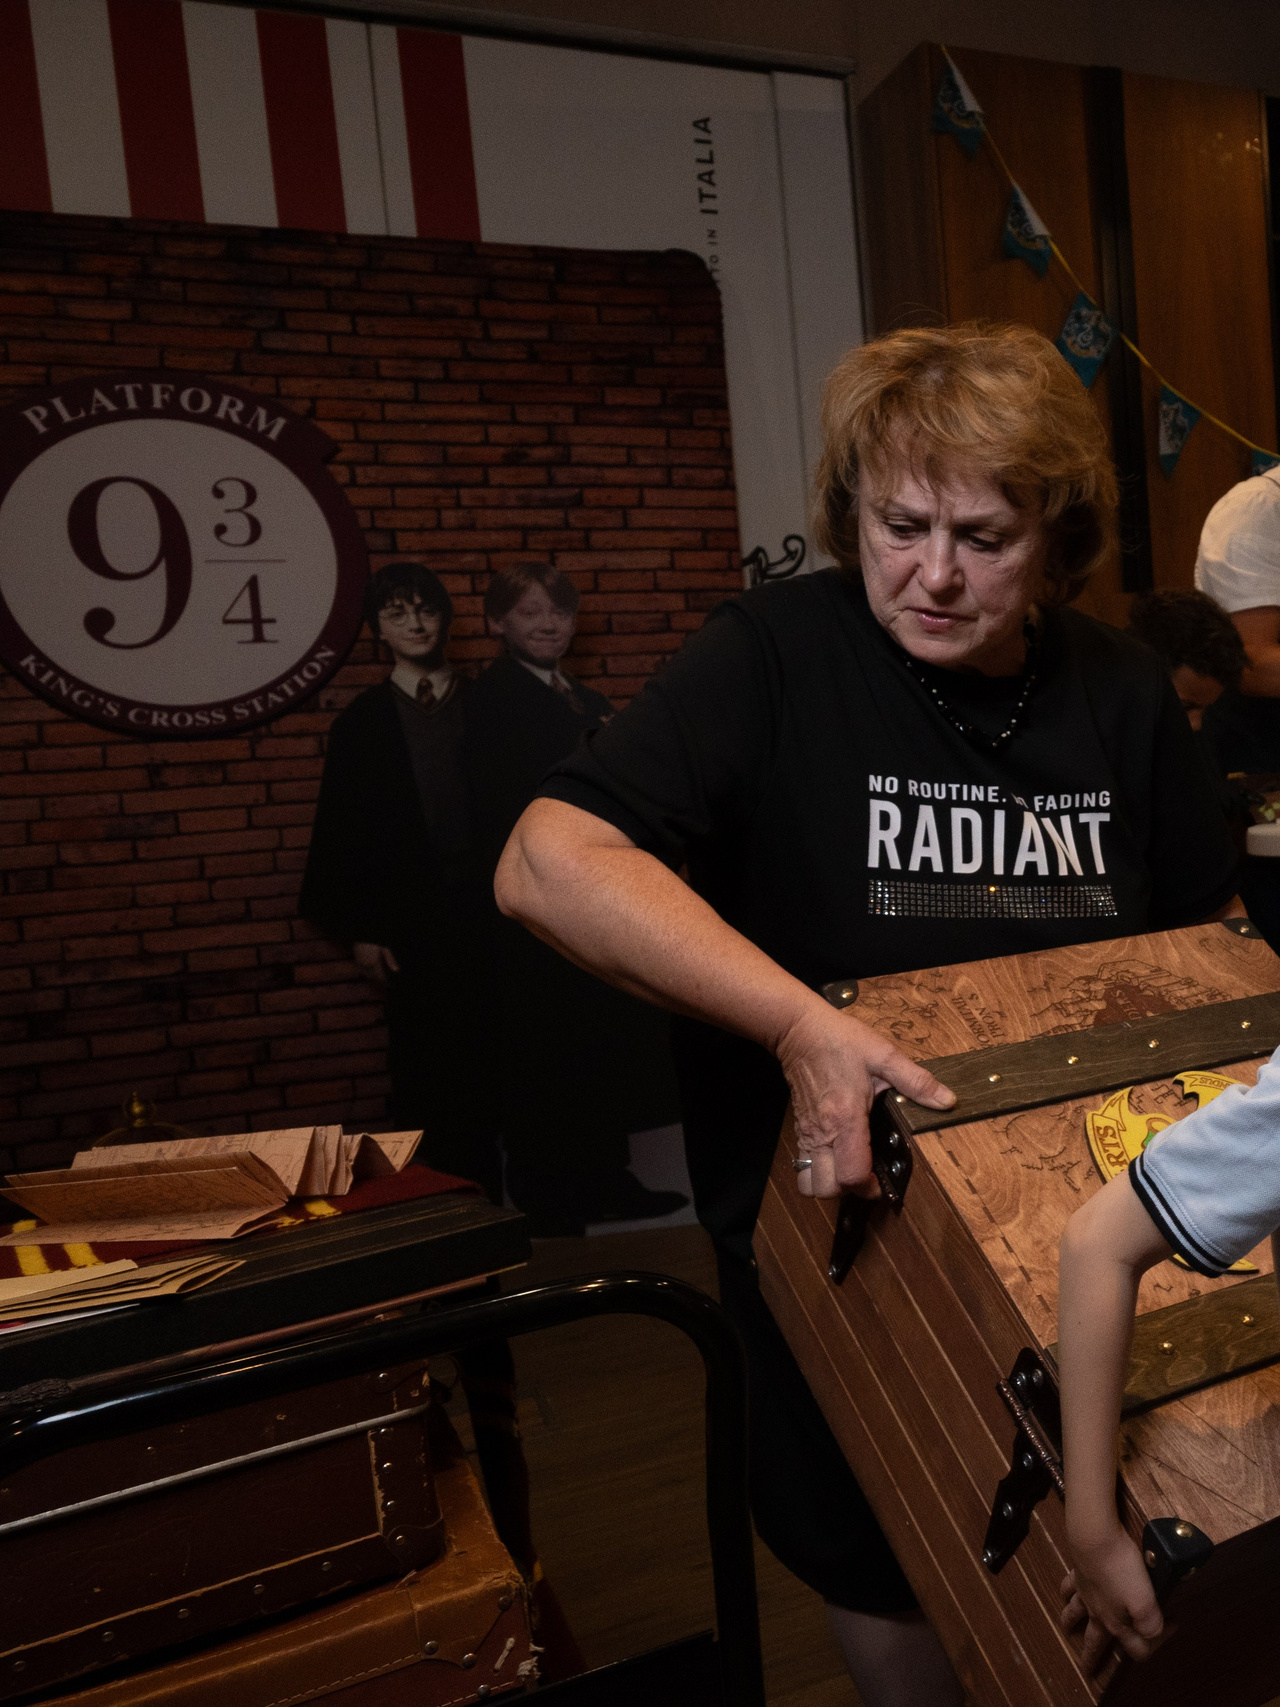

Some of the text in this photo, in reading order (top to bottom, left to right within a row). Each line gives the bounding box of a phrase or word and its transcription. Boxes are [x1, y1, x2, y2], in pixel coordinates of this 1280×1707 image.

[692, 116, 719, 214] ITALIA
[22, 382, 288, 443] PLATFORM
[19, 645, 337, 729] KING'S CROSS STATION
[868, 774, 899, 795] NO
[907, 779, 1007, 803] ROUTINE.
[1033, 790, 1112, 812] FADING
[867, 798, 1111, 876] RADIANT
[1095, 1124, 1129, 1170] RTS
